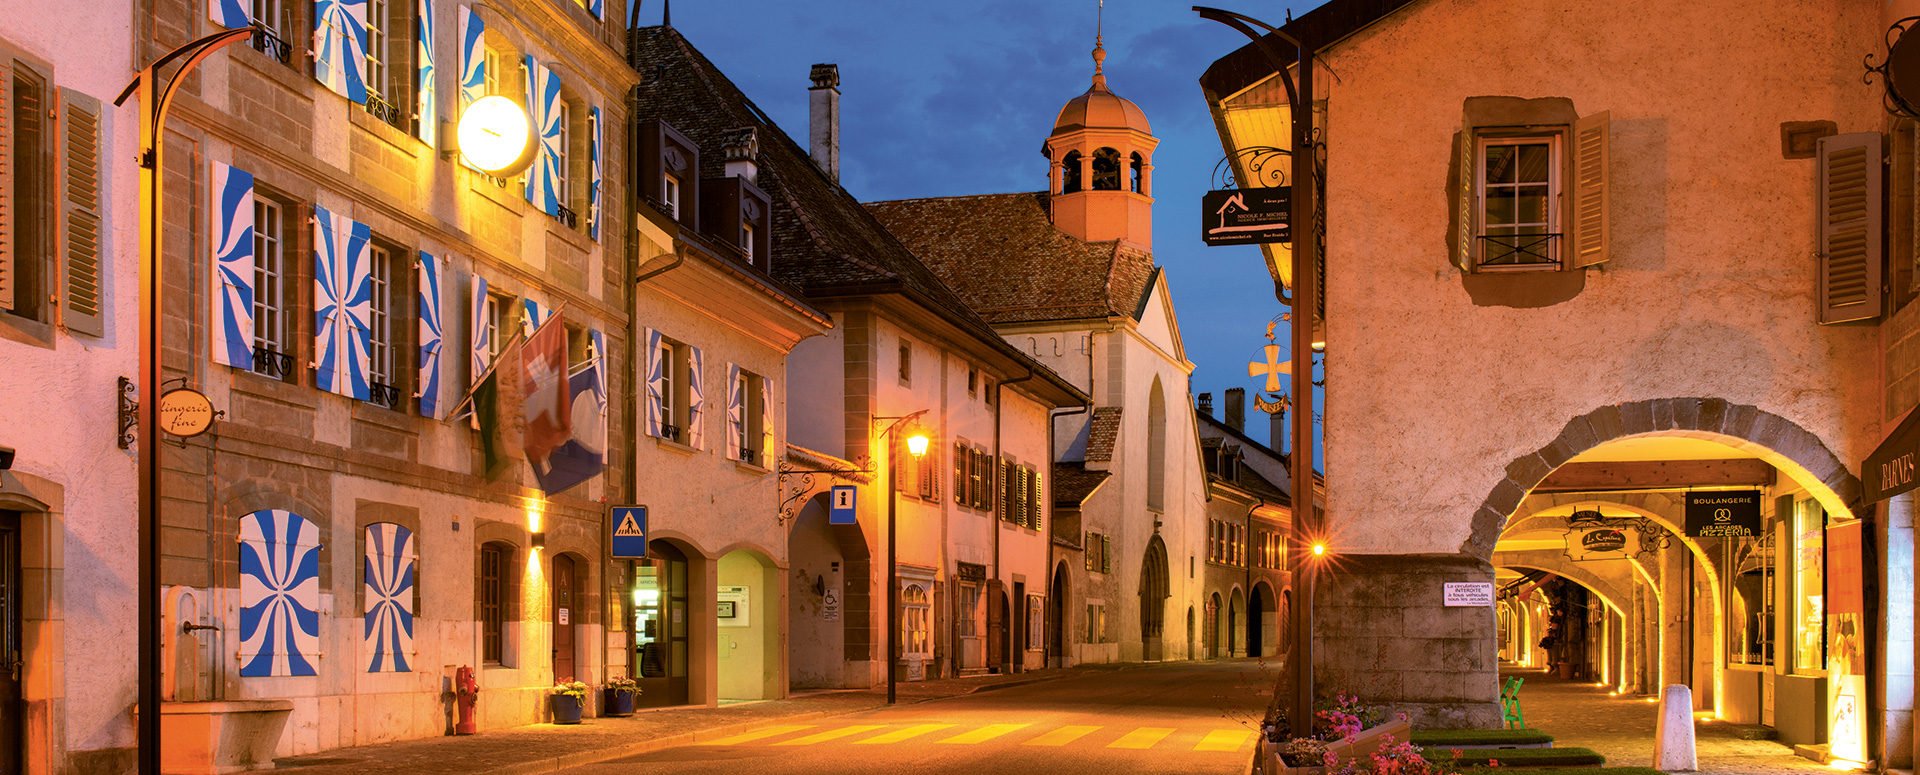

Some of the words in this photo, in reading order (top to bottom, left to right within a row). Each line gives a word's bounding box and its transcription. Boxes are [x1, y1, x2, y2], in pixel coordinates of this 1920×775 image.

[171, 416, 197, 431] fine
[1881, 452, 1914, 491] BARNES
[1700, 528, 1752, 536] PIZZERIA
